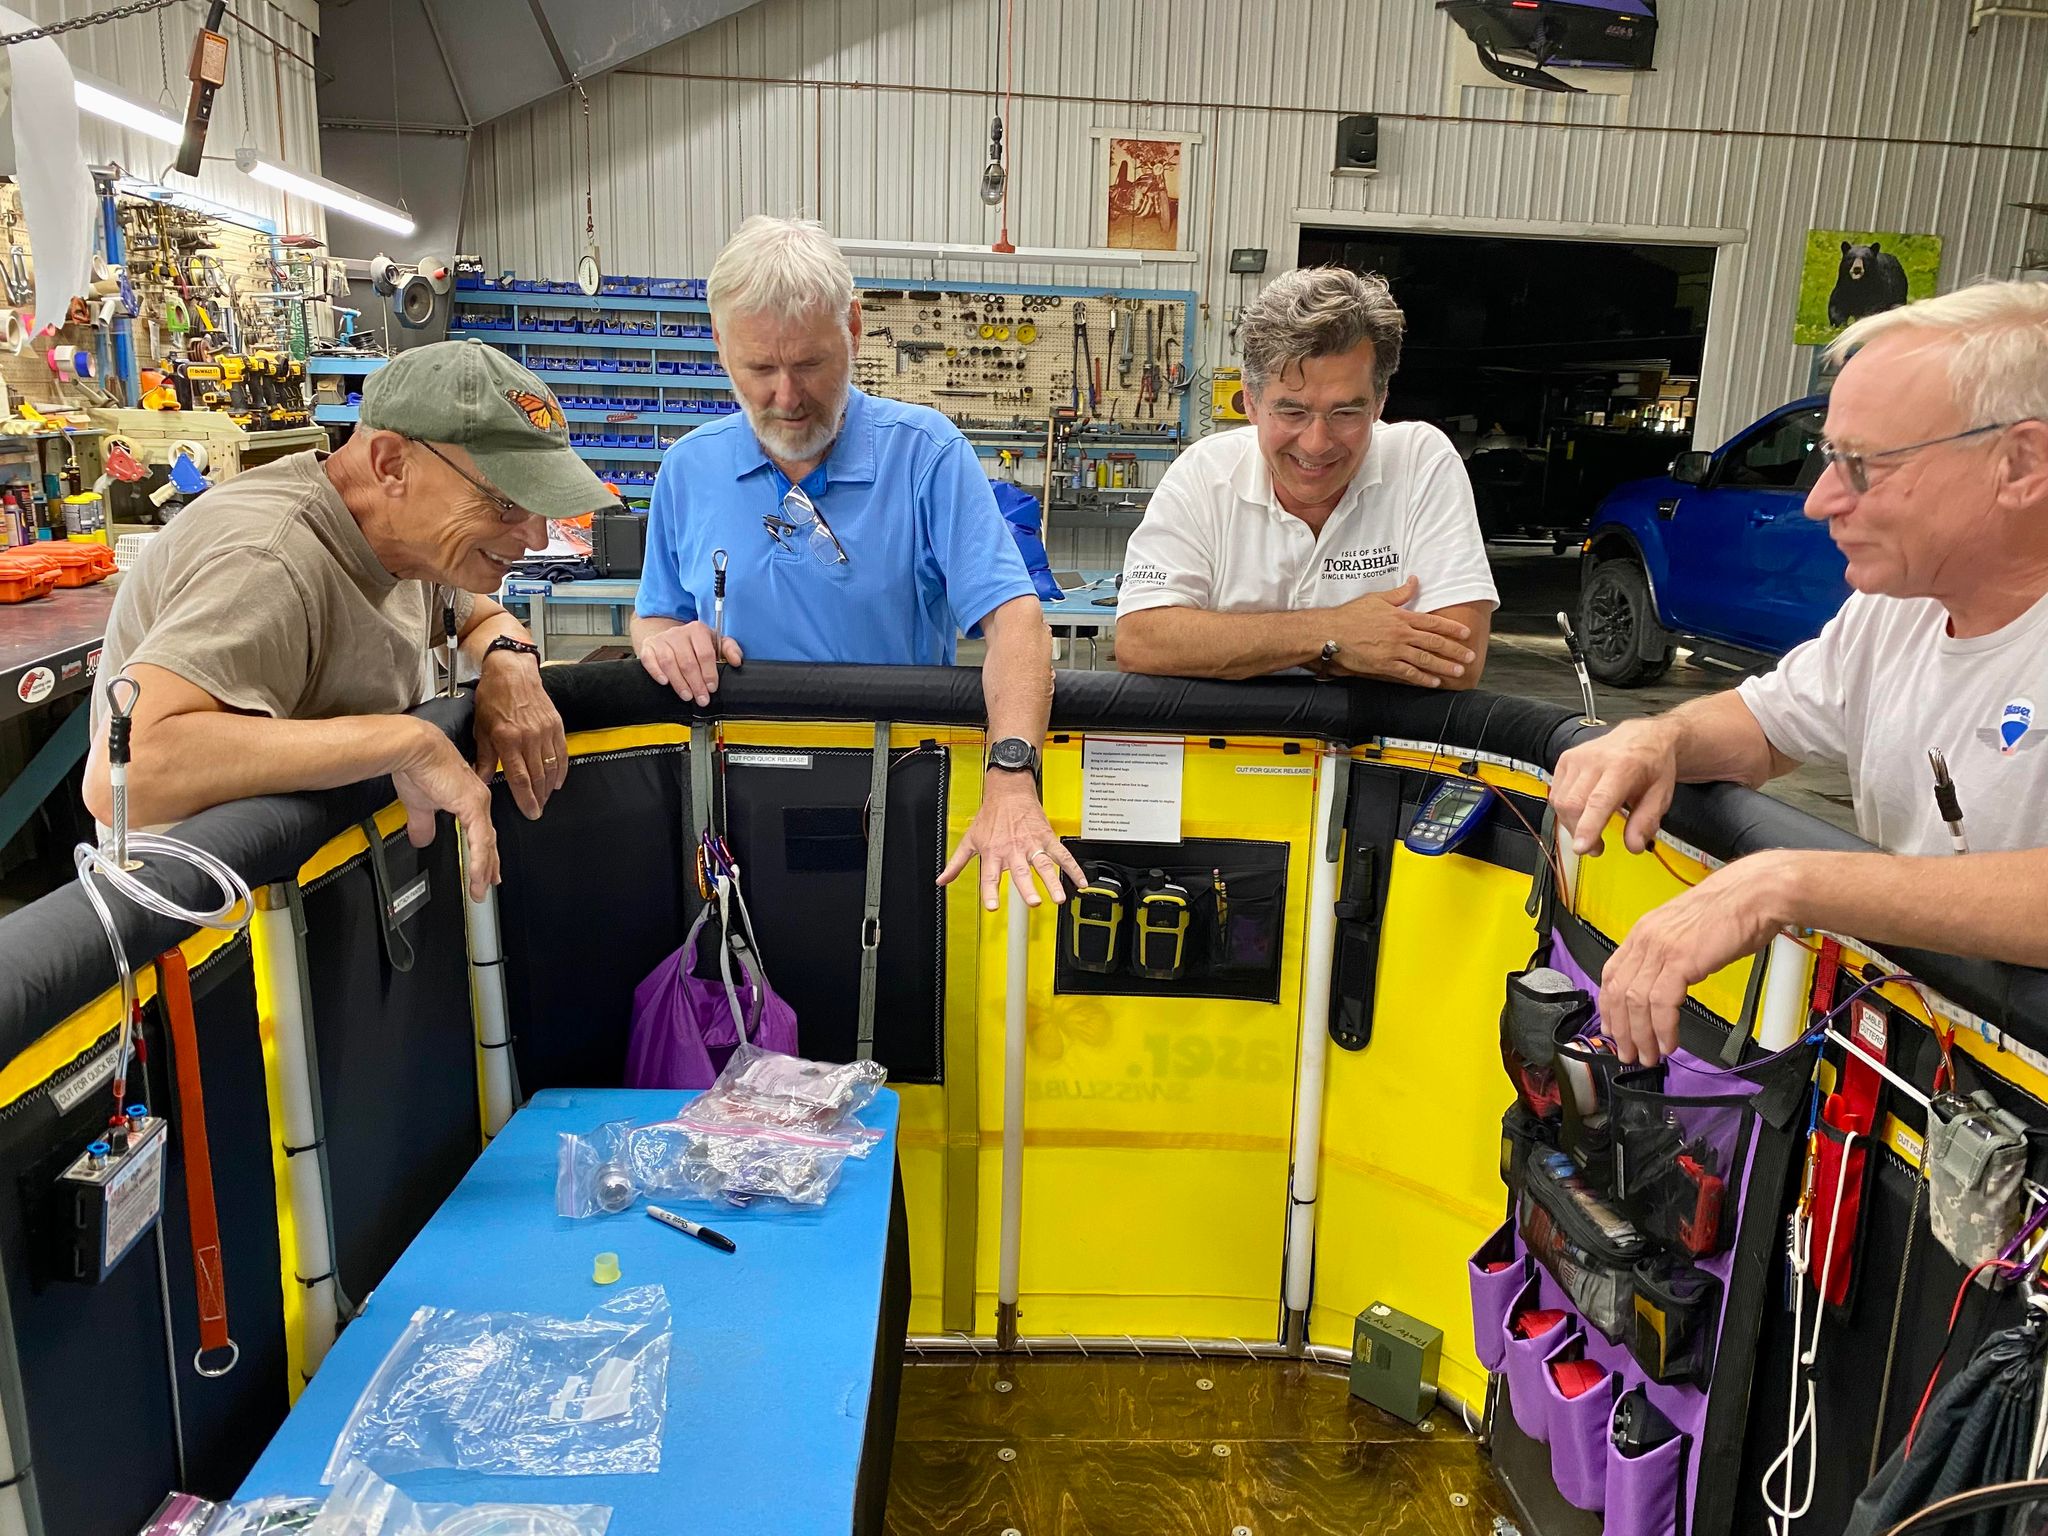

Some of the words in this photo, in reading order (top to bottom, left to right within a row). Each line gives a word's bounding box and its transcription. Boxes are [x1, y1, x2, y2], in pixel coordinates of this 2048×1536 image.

[1341, 550, 1357, 558] ISLE
[1373, 545, 1391, 554] SKYE
[1363, 569, 1386, 579] SCOTCH
[1865, 1012, 1882, 1028] CABLE
[1860, 1024, 1884, 1046] CUTTERS
[58, 1088, 74, 1105] CUT
[73, 1078, 88, 1093] FOR
[86, 1063, 106, 1081] QUICK
[1898, 1133, 1910, 1148] CUT
